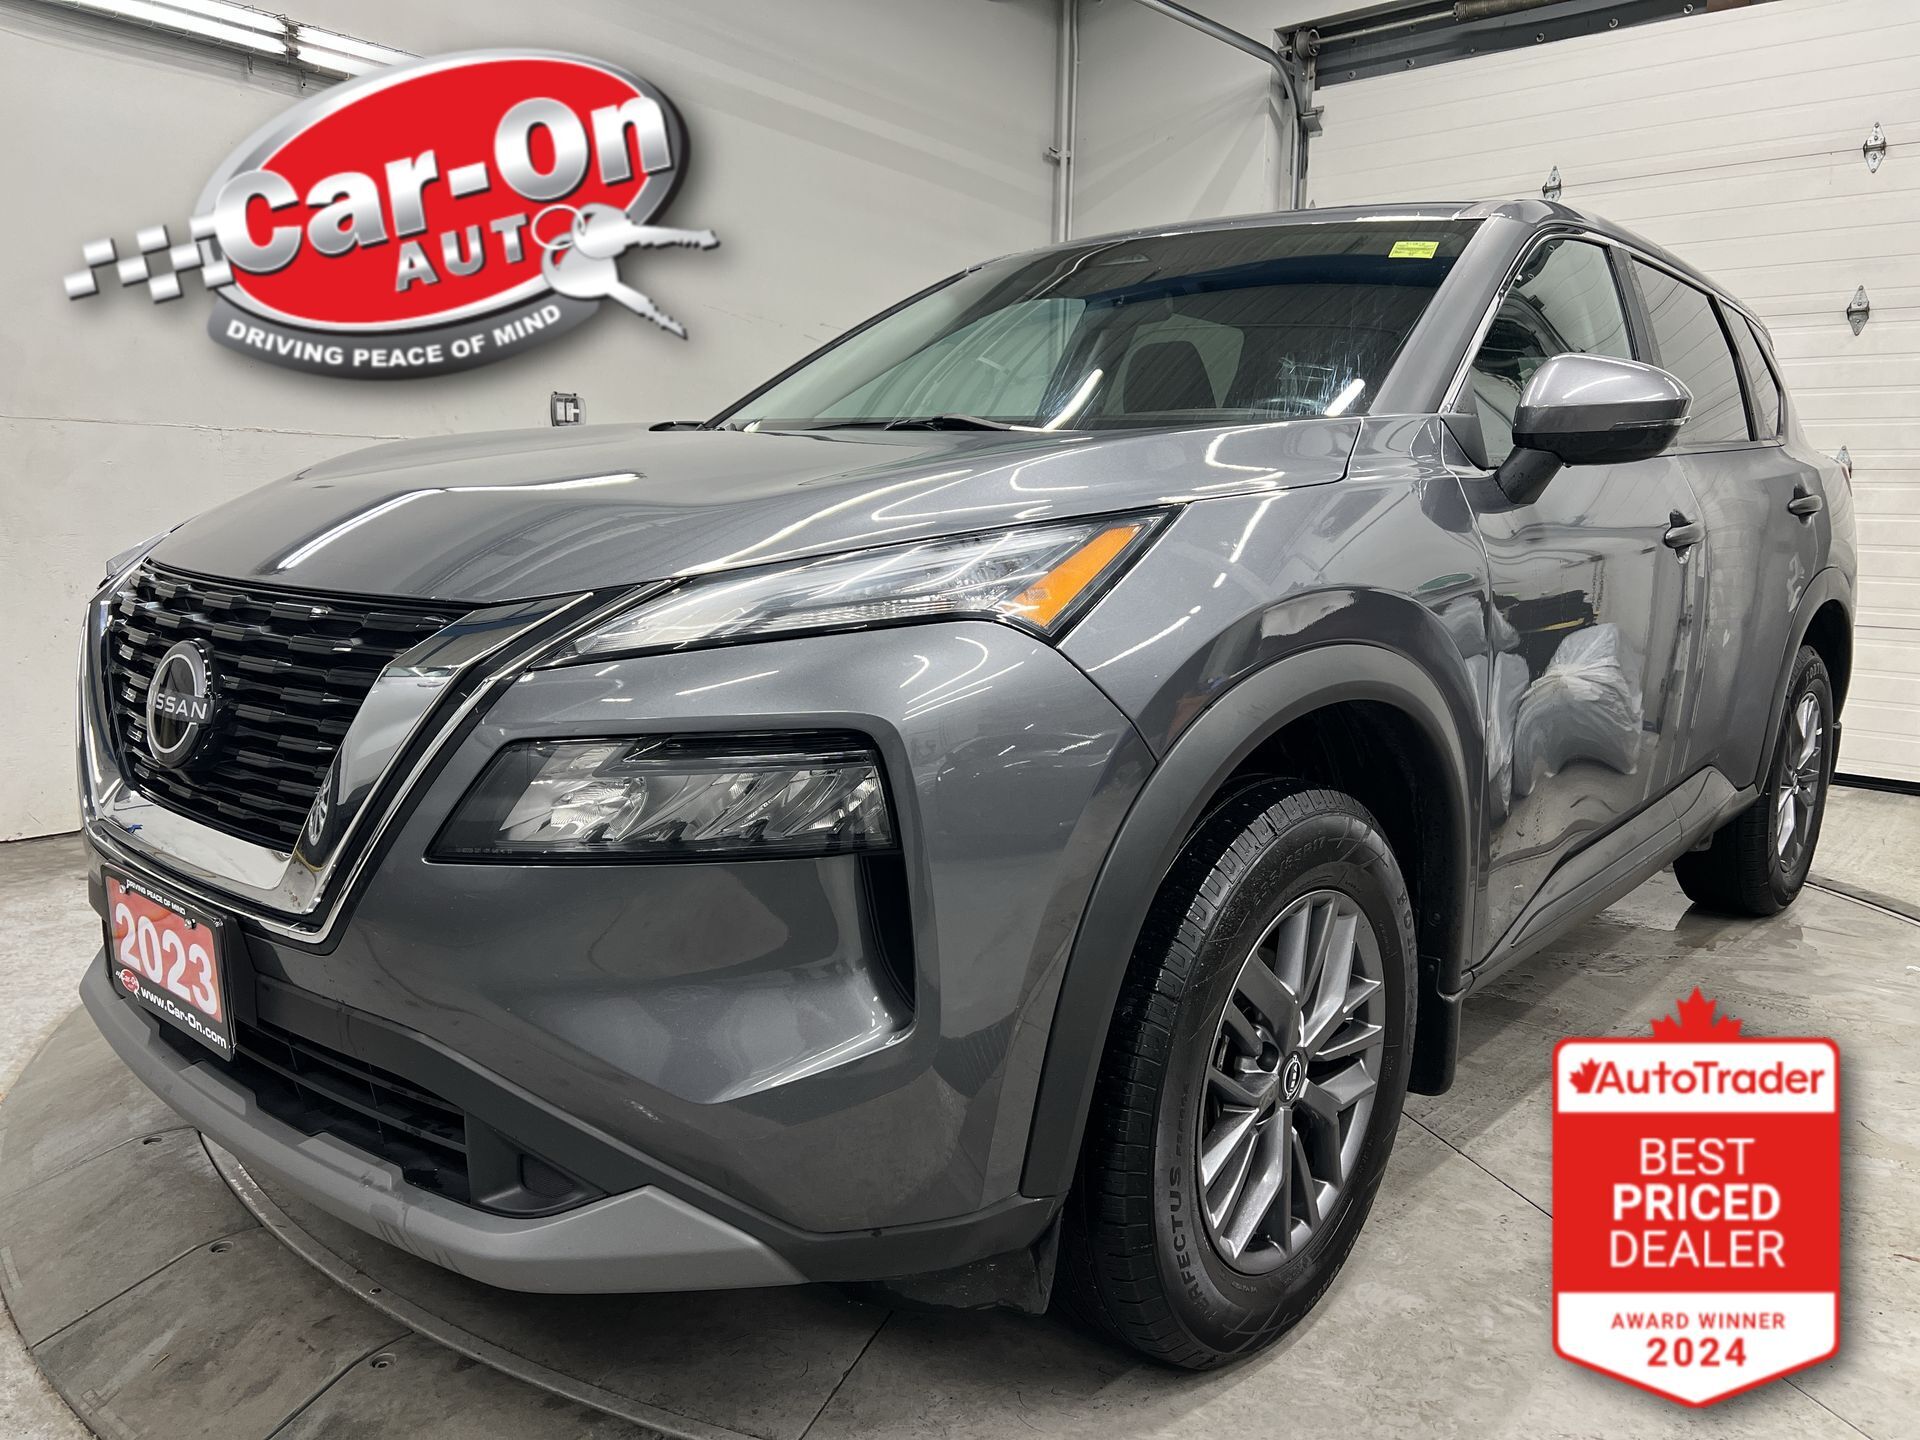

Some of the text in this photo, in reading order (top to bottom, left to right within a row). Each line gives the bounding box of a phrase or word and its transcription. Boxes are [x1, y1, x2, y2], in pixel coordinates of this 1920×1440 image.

[147, 889, 163, 904] PEACE
[171, 902, 186, 915] MIND
[115, 902, 218, 1015] 2023
[141, 986, 227, 1049] www.Car-On.com
